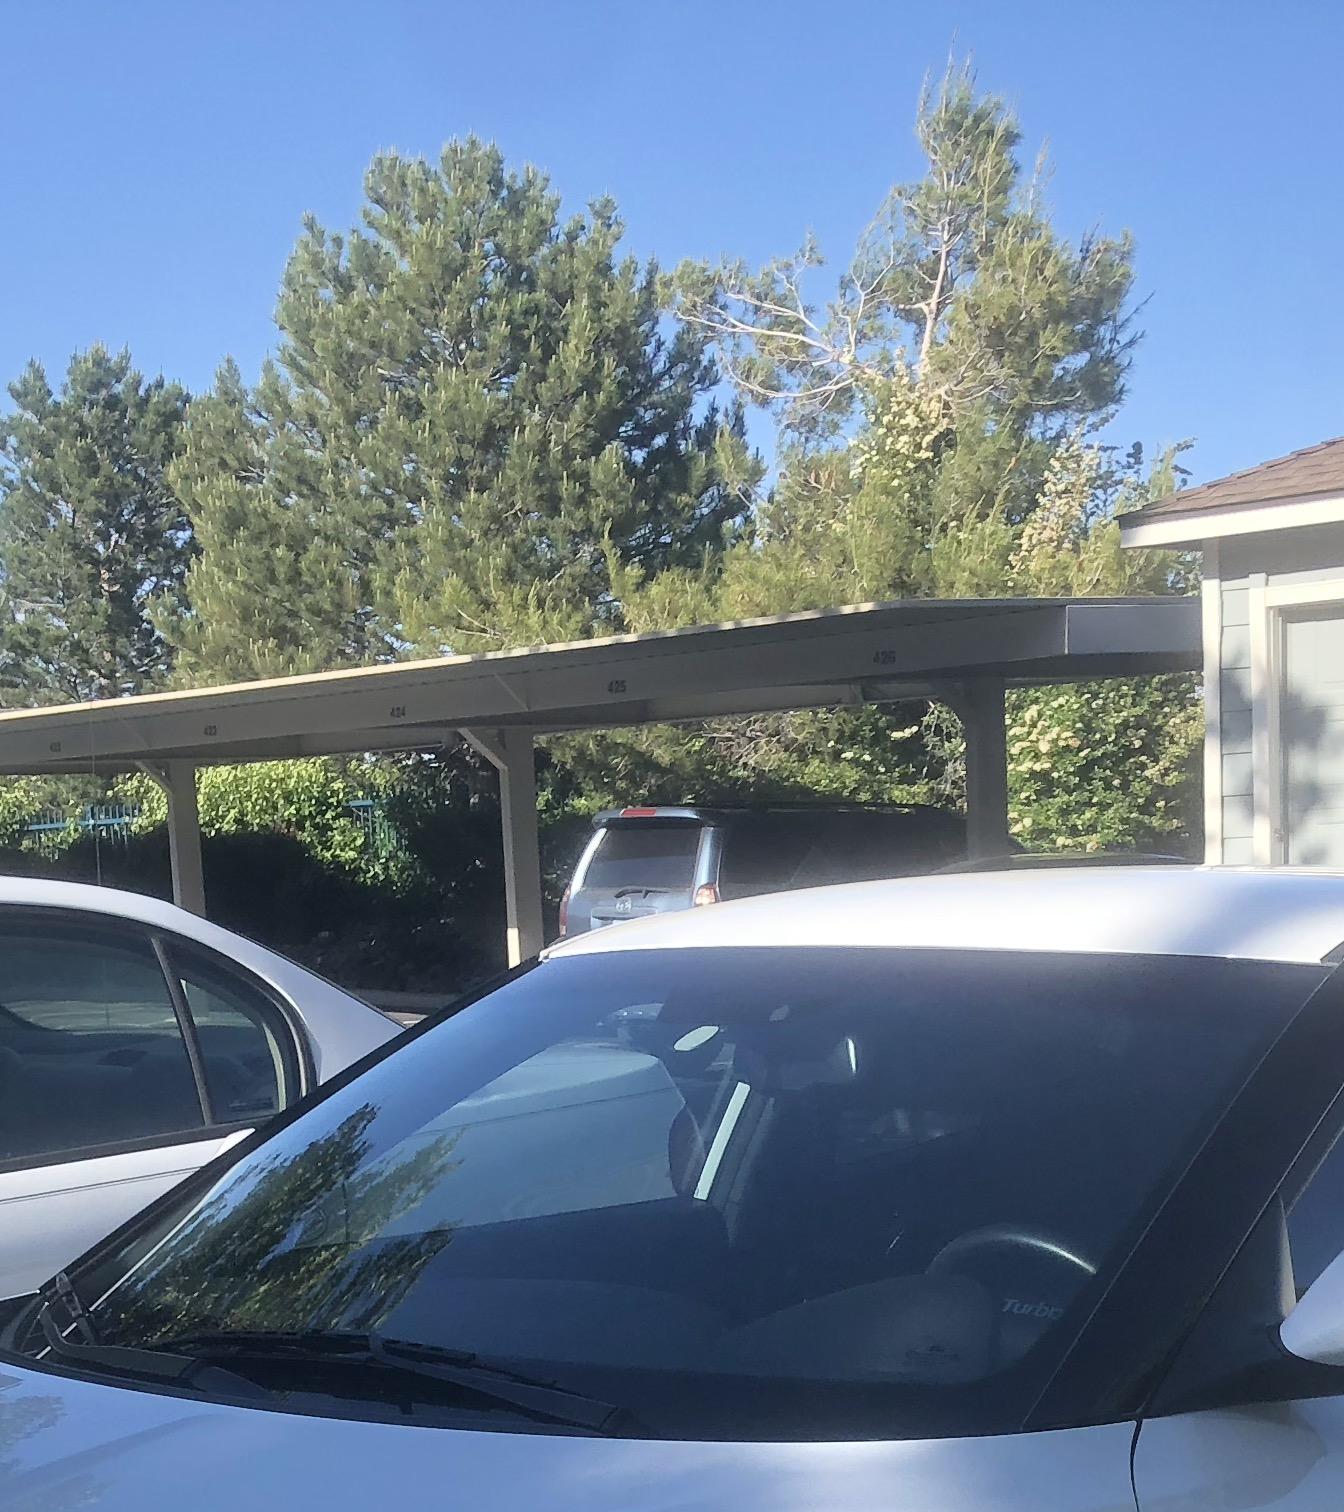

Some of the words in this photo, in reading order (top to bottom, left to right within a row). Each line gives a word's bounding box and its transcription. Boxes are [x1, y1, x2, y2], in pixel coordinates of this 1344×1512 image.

[607, 679, 626, 693] 425
[390, 706, 406, 718] 424
[1001, 1298, 1064, 1321] Turbo
